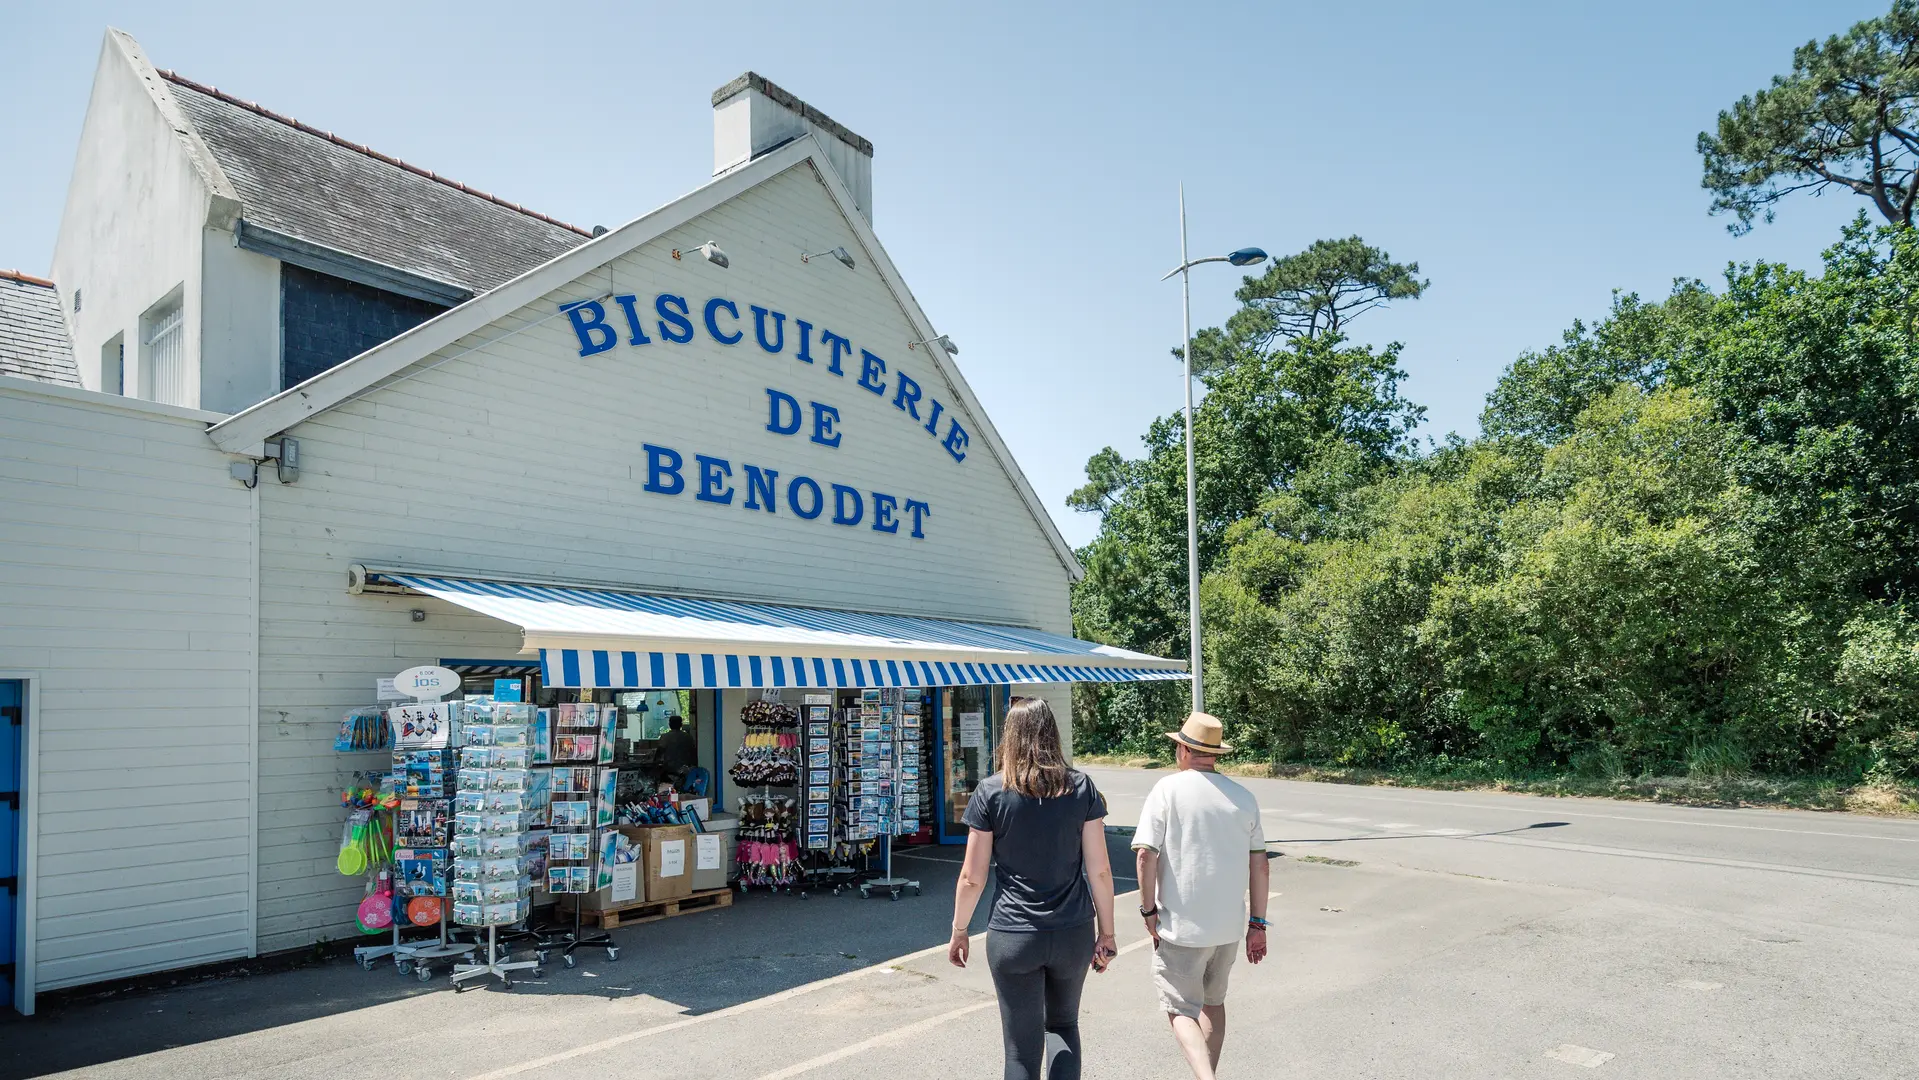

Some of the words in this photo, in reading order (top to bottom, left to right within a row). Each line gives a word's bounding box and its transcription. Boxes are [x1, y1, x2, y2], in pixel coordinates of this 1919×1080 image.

[558, 292, 969, 464] BISCUITERIE
[765, 387, 843, 449] DE
[641, 443, 931, 540] BENODET
